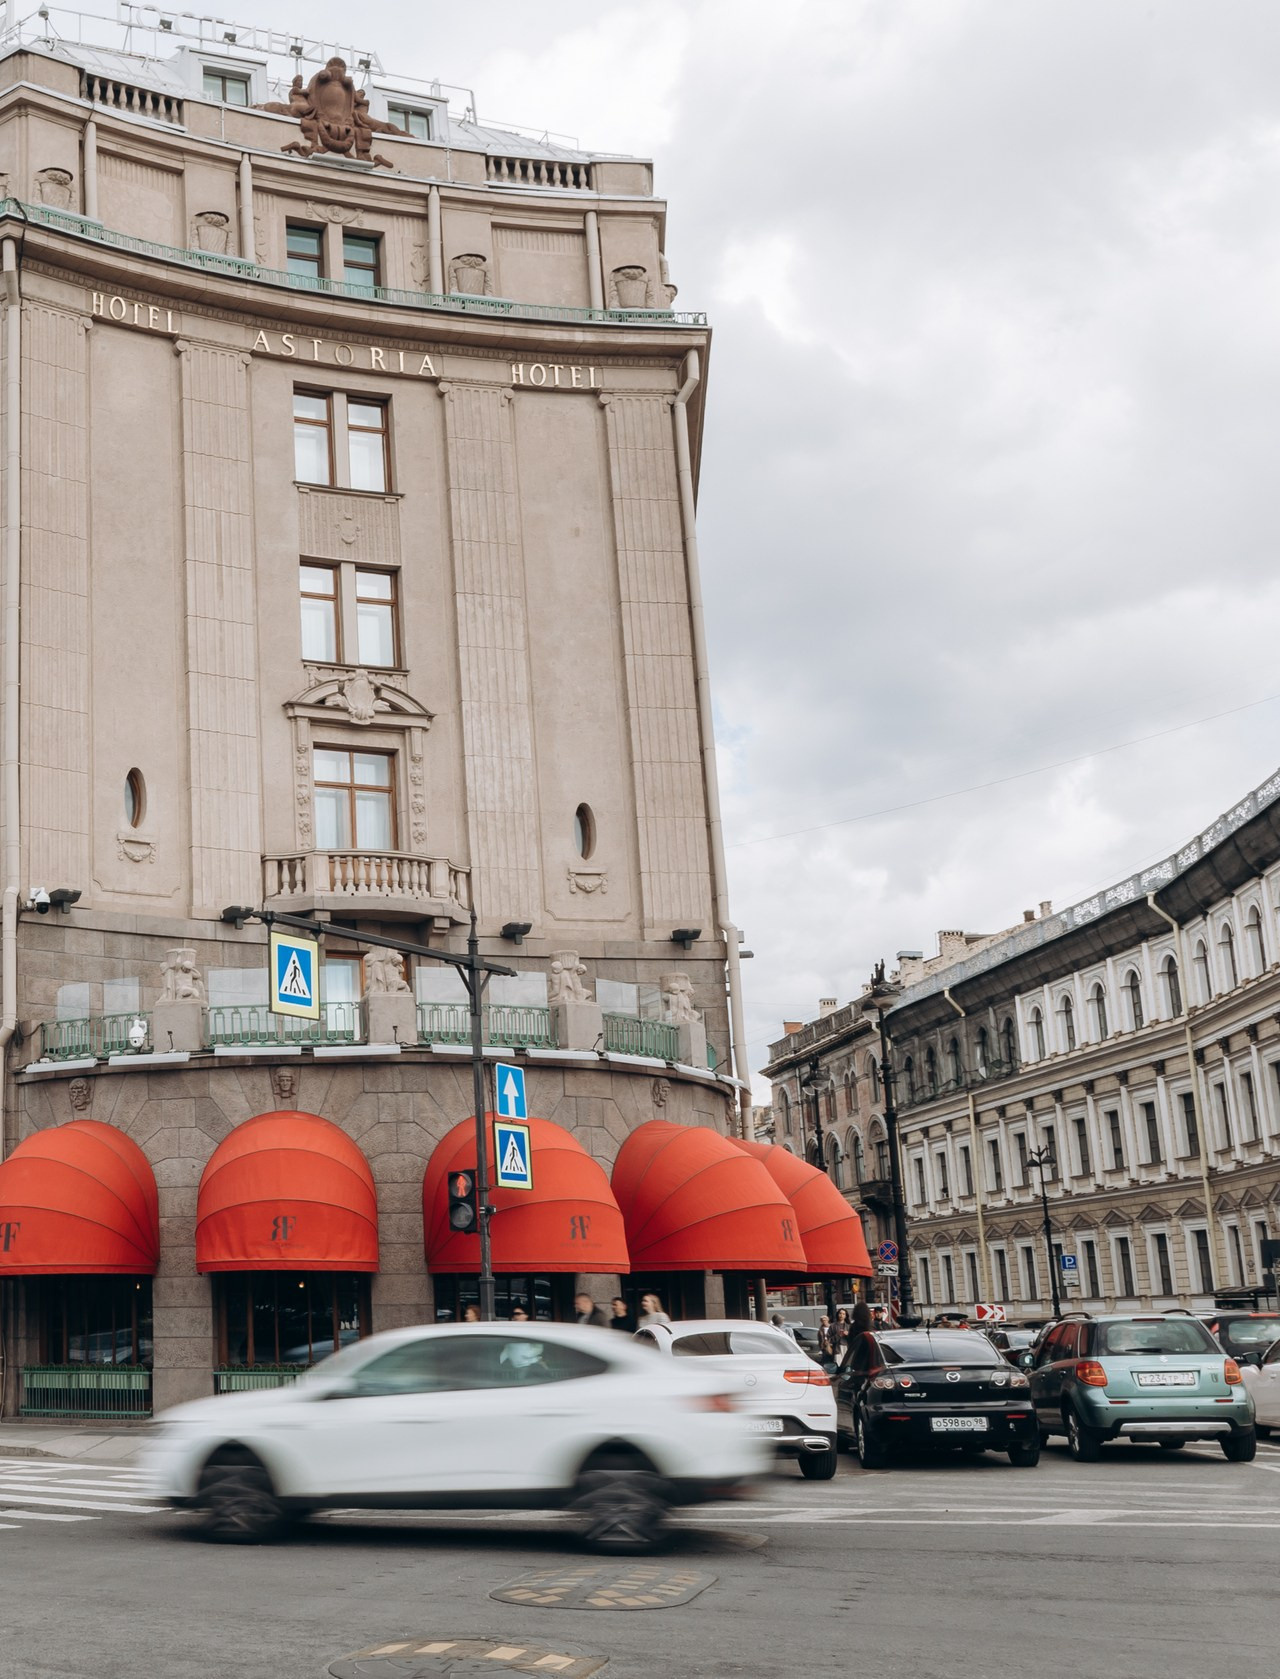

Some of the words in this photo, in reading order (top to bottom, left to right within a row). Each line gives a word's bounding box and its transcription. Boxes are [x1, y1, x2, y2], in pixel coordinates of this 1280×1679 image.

[92, 291, 179, 334] HOTEL
[252, 329, 437, 377] ASTORIA
[511, 363, 602, 388] HOTEL
